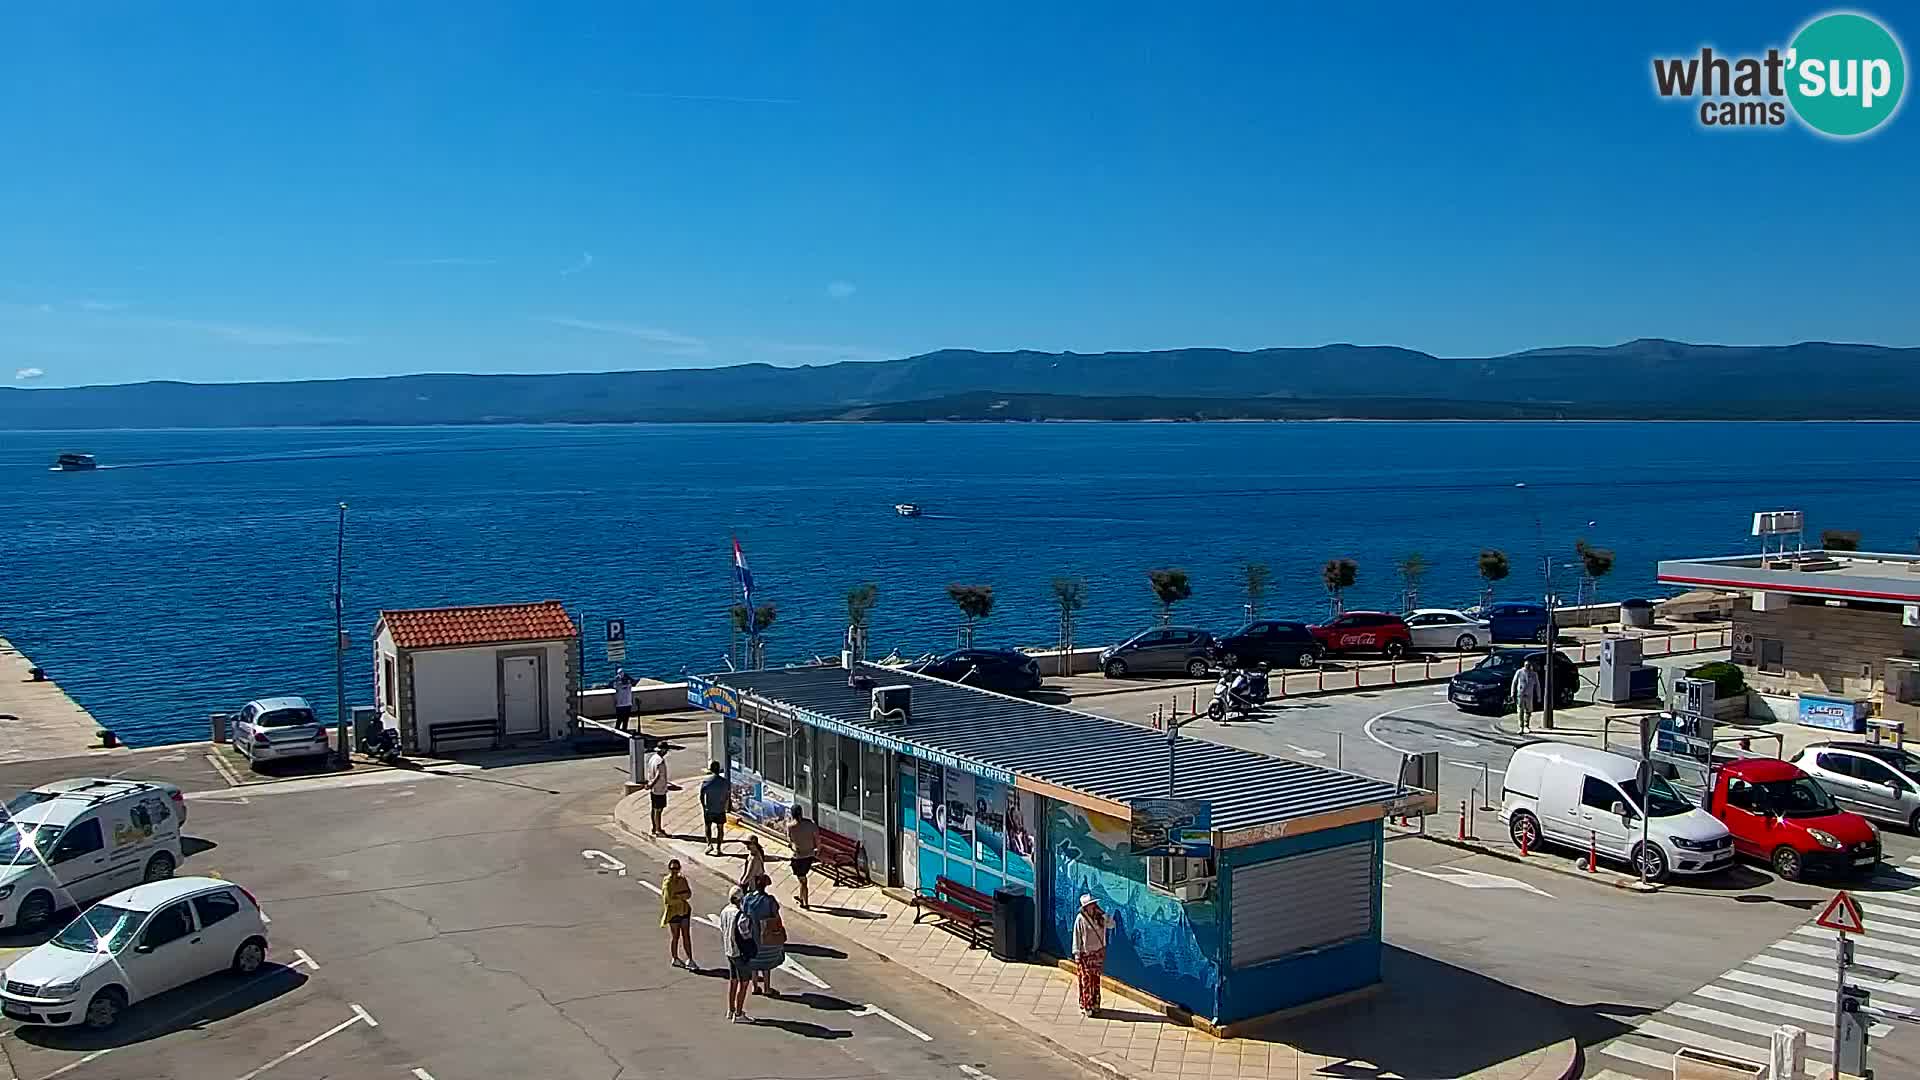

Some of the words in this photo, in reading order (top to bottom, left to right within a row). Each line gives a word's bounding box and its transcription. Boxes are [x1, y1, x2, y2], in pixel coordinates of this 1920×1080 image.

[610, 622, 621, 639] P
[874, 734, 903, 752] POSTAJA
[912, 746, 926, 758] BUS
[927, 751, 957, 769] STATION
[959, 760, 985, 777] TICKET
[985, 768, 1011, 783] OFFICE
